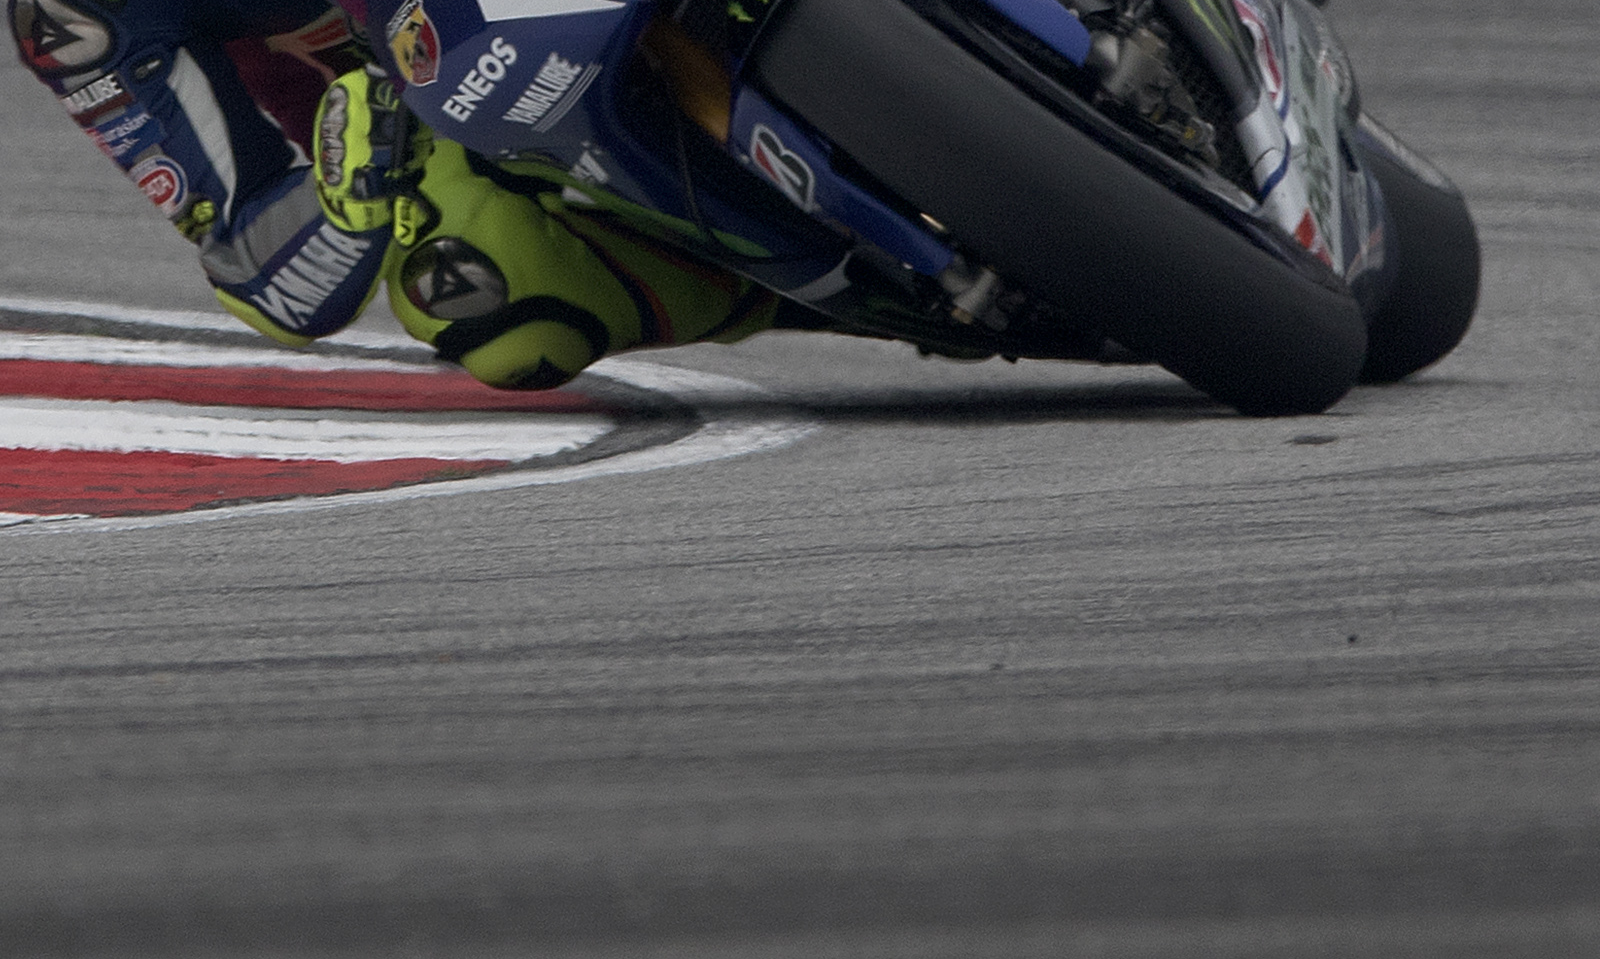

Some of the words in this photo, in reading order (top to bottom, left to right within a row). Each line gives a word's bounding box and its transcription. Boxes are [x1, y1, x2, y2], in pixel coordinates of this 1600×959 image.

[441, 36, 517, 123] ENEOS
[501, 51, 584, 125] YAMALUBE
[249, 222, 372, 330] YAMAHA
